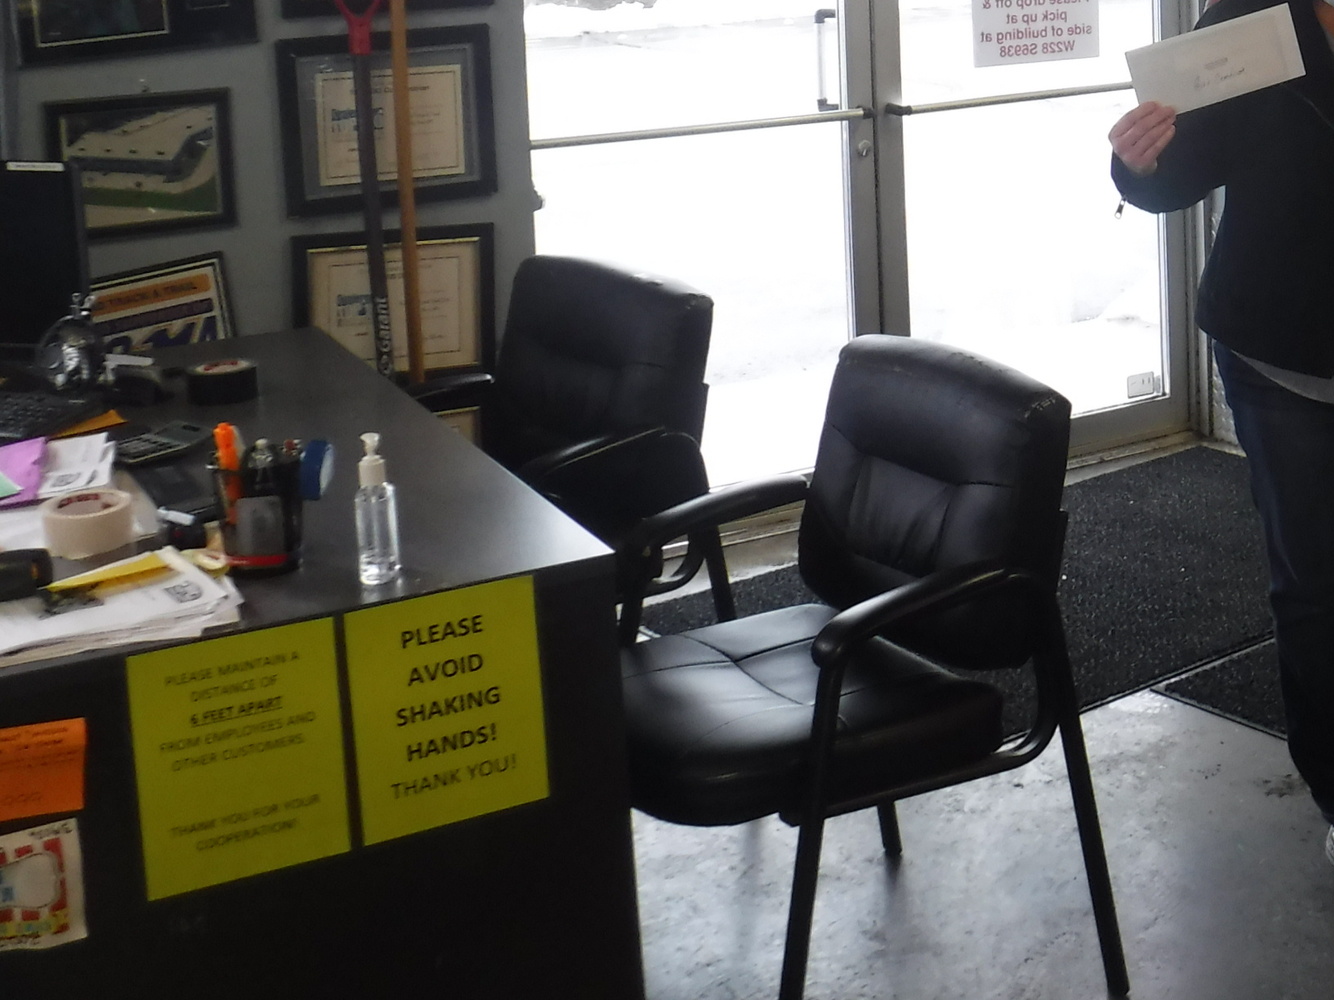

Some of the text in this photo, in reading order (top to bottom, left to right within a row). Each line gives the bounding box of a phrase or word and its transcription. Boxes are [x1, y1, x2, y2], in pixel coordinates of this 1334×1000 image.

[401, 614, 484, 649] PLEASE
[164, 650, 301, 687] PLEASE MAINTAIN A
[189, 673, 280, 703] DISTANCE OF
[408, 653, 484, 687] AVOID
[190, 695, 284, 726] 6 FEET APART
[395, 686, 501, 728] SHAKING
[159, 710, 317, 753] FROM EMPLOYEES AND
[406, 722, 498, 763] HANDS!
[171, 732, 307, 773] OTHER CUSTOMERS
[390, 753, 517, 800] THANK YOU!
[168, 793, 322, 839] THANK YOU FOR YOUR
